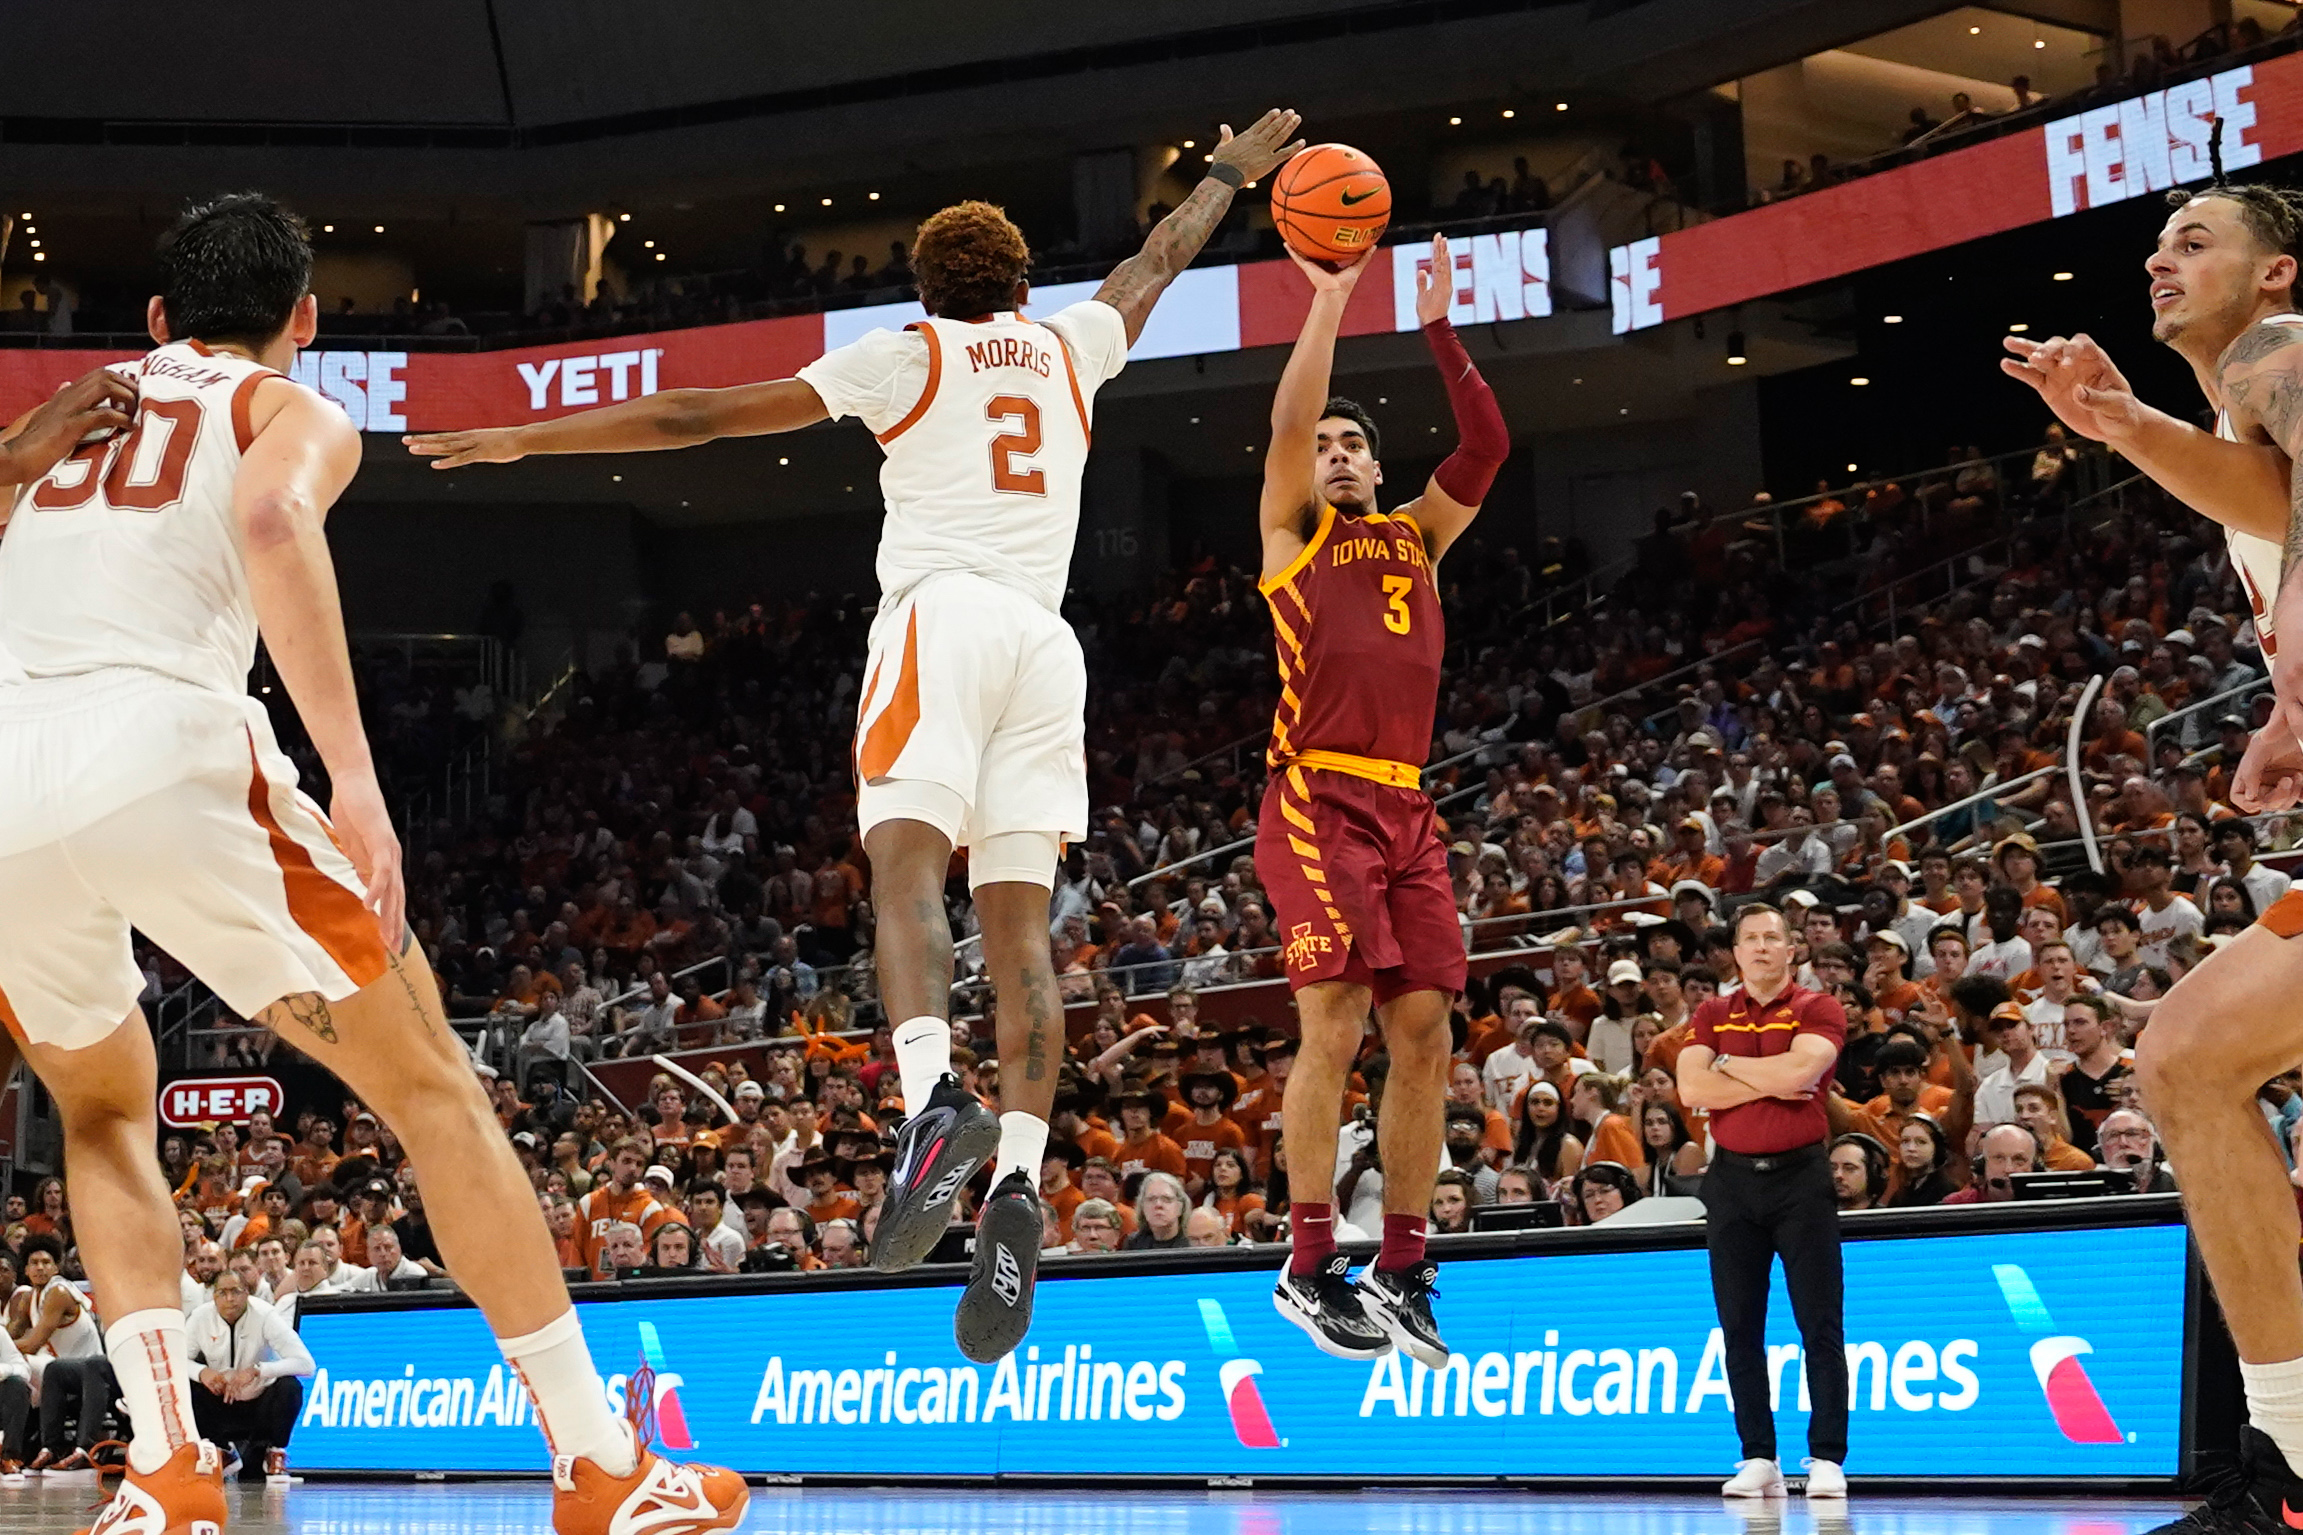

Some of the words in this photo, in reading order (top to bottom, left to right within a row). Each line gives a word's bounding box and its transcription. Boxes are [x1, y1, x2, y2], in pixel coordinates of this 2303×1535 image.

[2044, 65, 2262, 218] FENSE
[516, 348, 658, 411] YETI
[965, 338, 1052, 378] MORRIS
[984, 393, 1048, 498] 2
[1332, 538, 1390, 567] IOWA
[1382, 574, 1413, 635] 3
[1286, 936, 1332, 965] STATE
[302, 1364, 473, 1427] American
[474, 1364, 627, 1426] Airs
[751, 1351, 979, 1423] American
[983, 1344, 1186, 1421] Airlines
[1359, 1329, 1678, 1417] American
